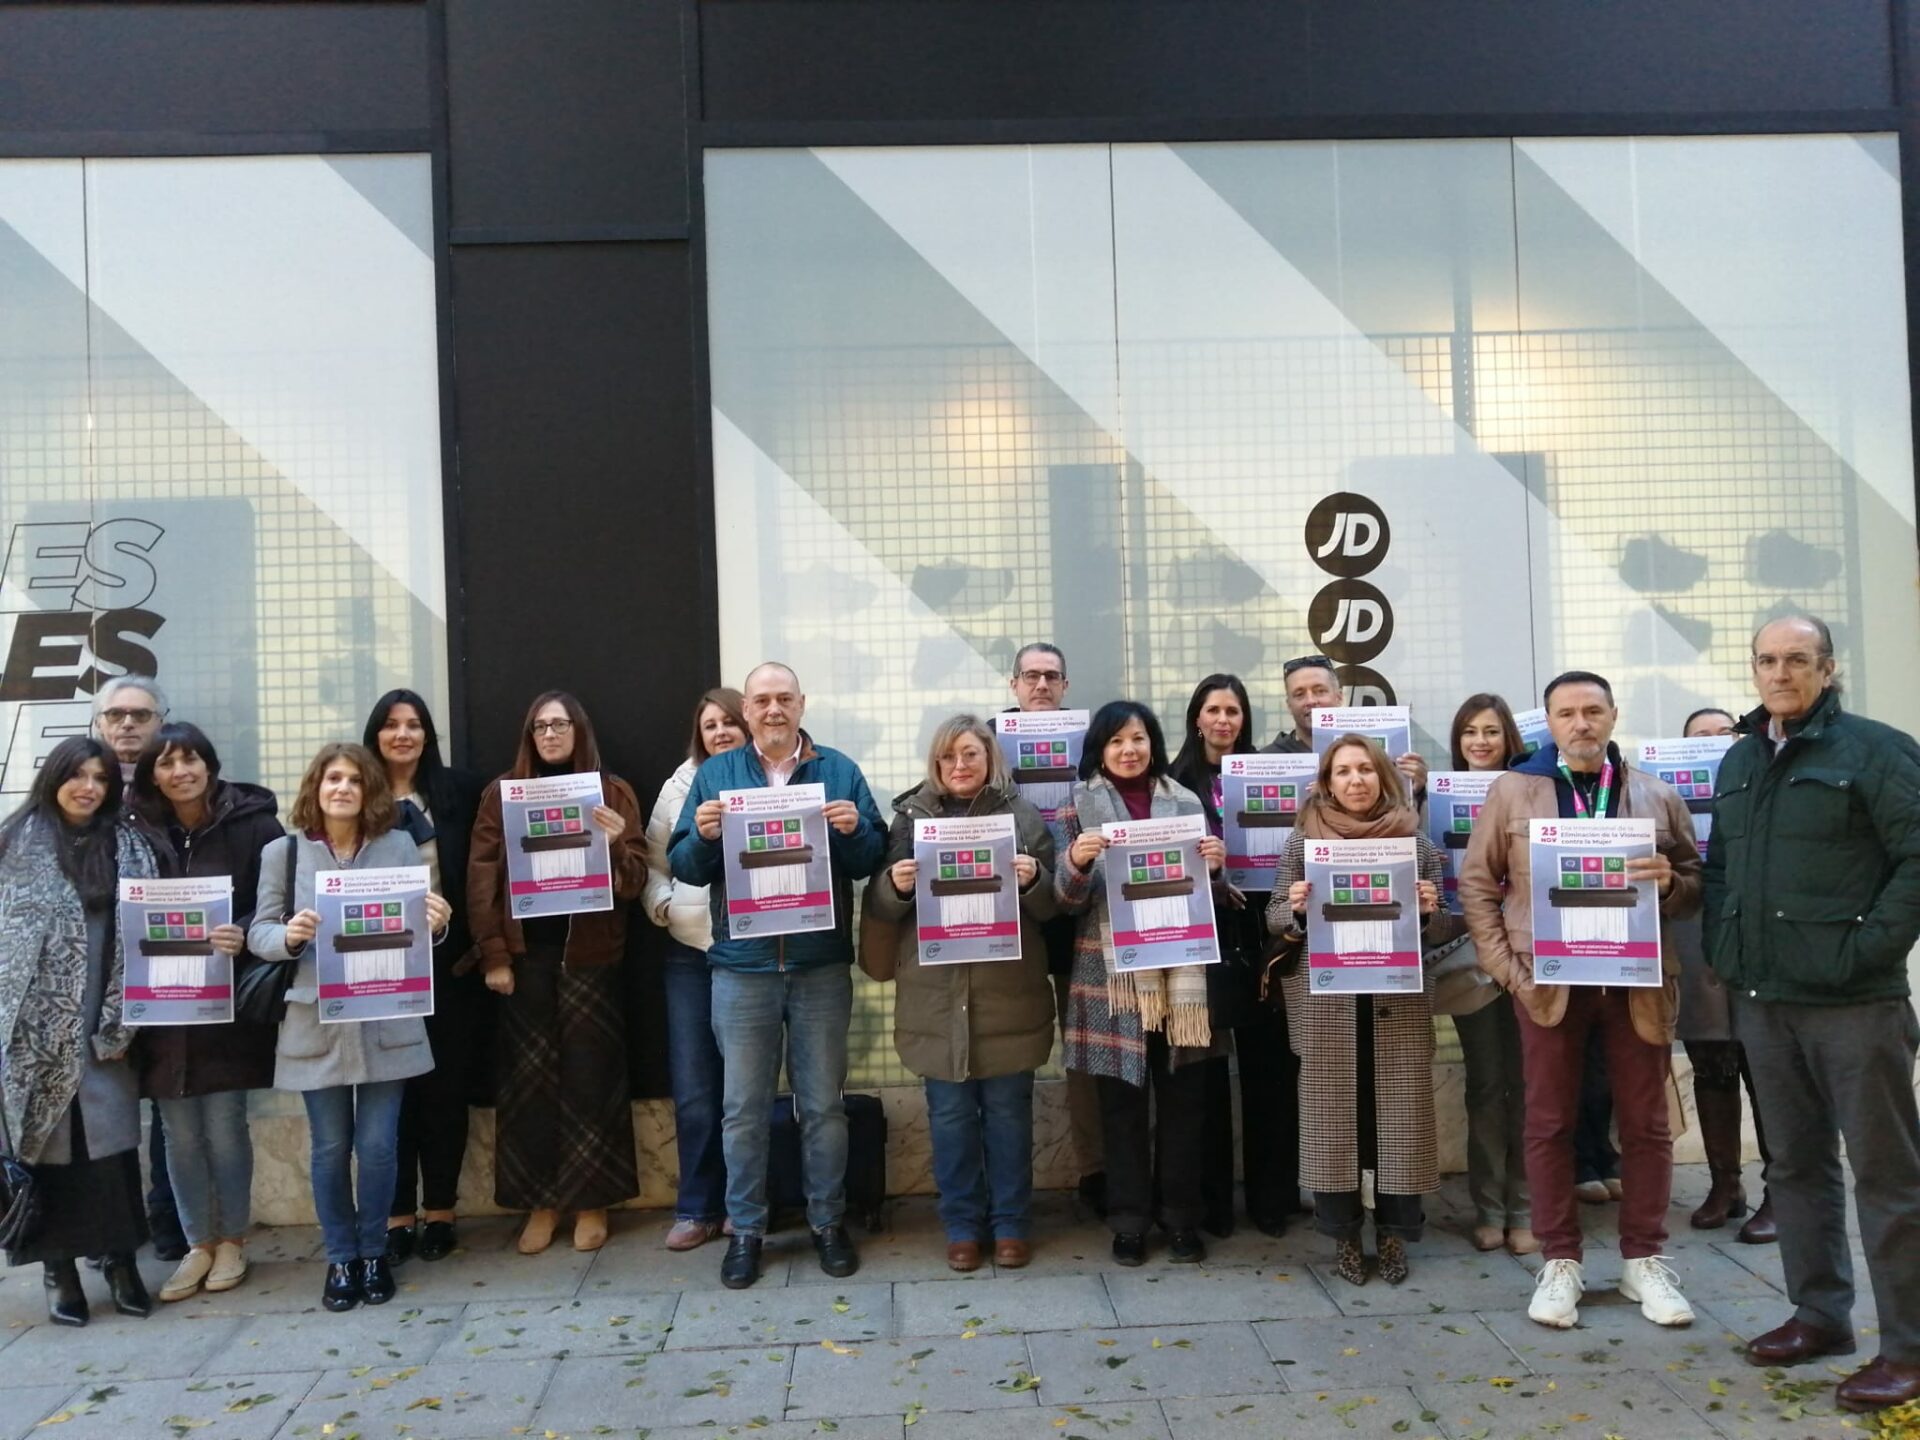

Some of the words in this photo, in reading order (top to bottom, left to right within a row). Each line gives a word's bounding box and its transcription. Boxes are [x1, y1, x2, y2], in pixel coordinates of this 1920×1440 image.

[1318, 512, 1381, 559] JD
[1321, 598, 1384, 645] JD
[0, 608, 166, 701] ES
[923, 826, 936, 834] 25
[1113, 829, 1127, 838] 25
[1541, 827, 1557, 836] 25
[1315, 847, 1329, 856] 25
[326, 878, 341, 887] 25
